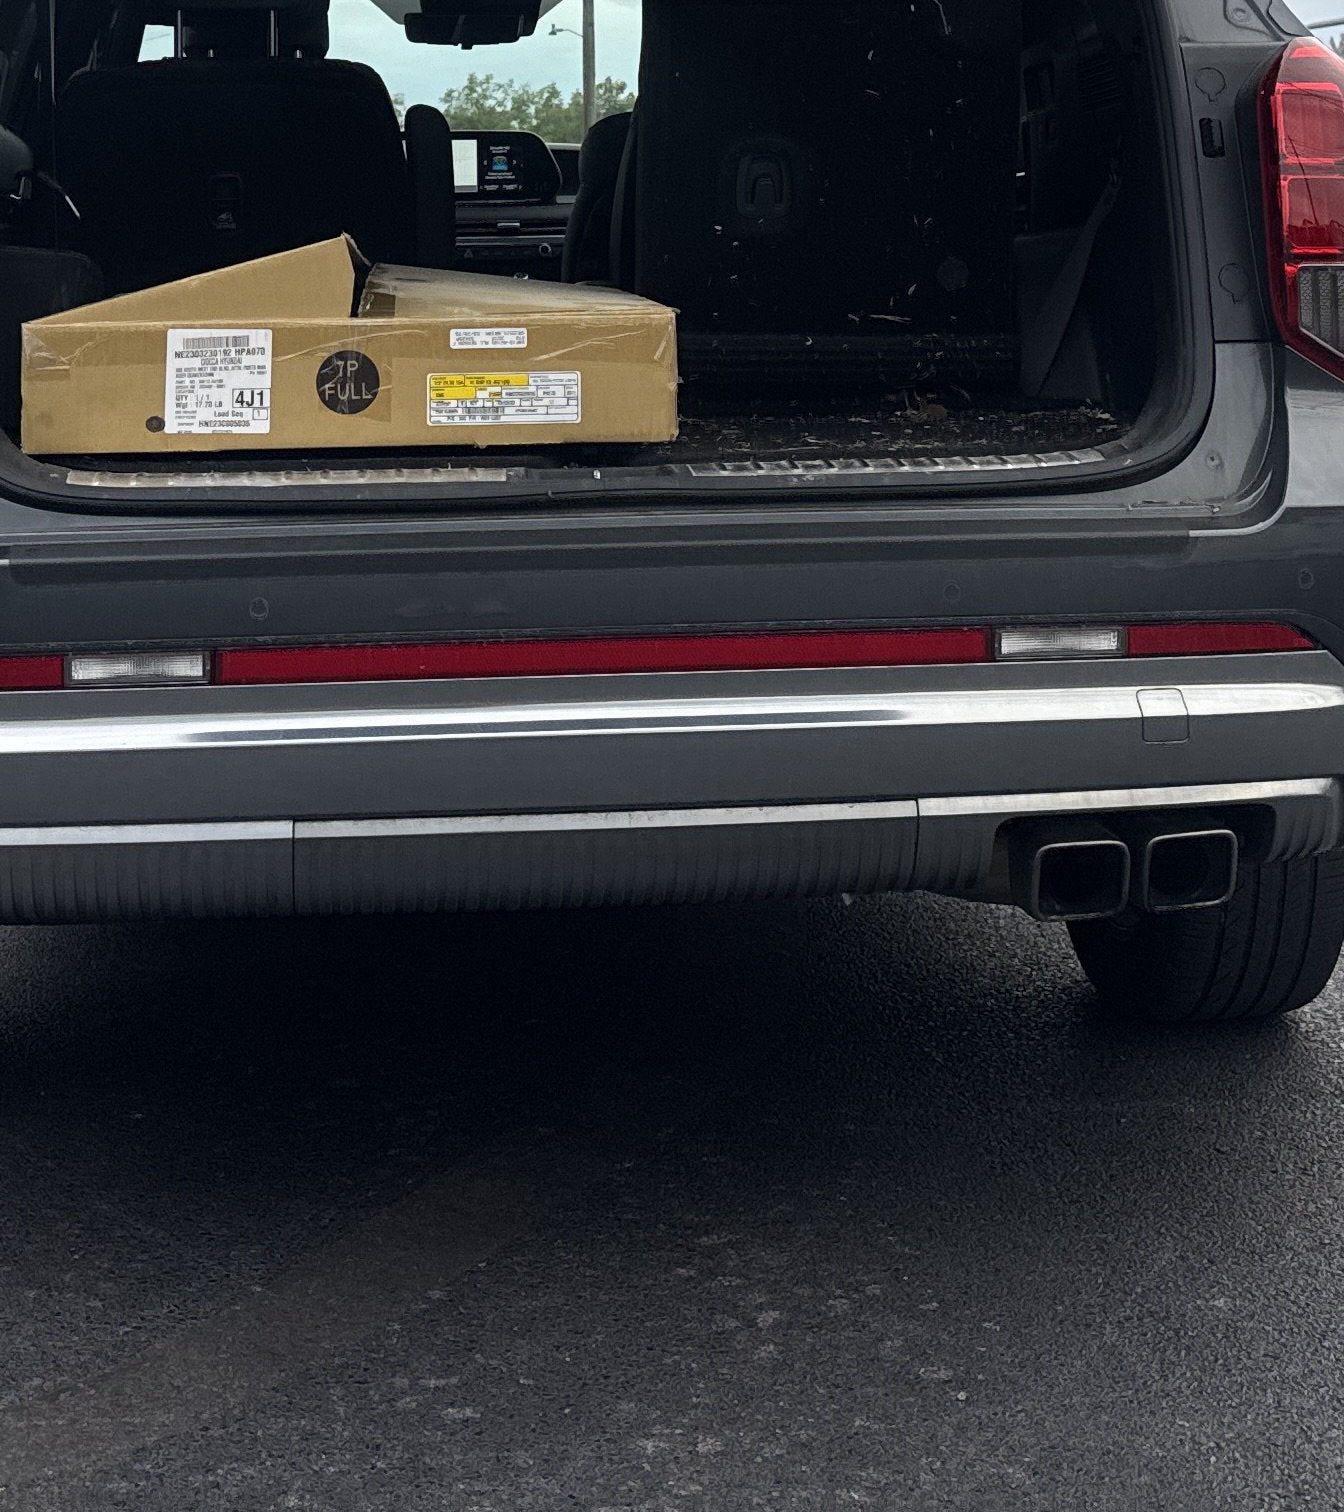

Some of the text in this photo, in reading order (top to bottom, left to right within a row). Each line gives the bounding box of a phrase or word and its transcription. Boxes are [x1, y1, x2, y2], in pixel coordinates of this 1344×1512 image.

[325, 382, 374, 401] FULL
[175, 394, 189, 402] QTY
[235, 390, 264, 407] 4J1
[213, 410, 230, 418] Load
